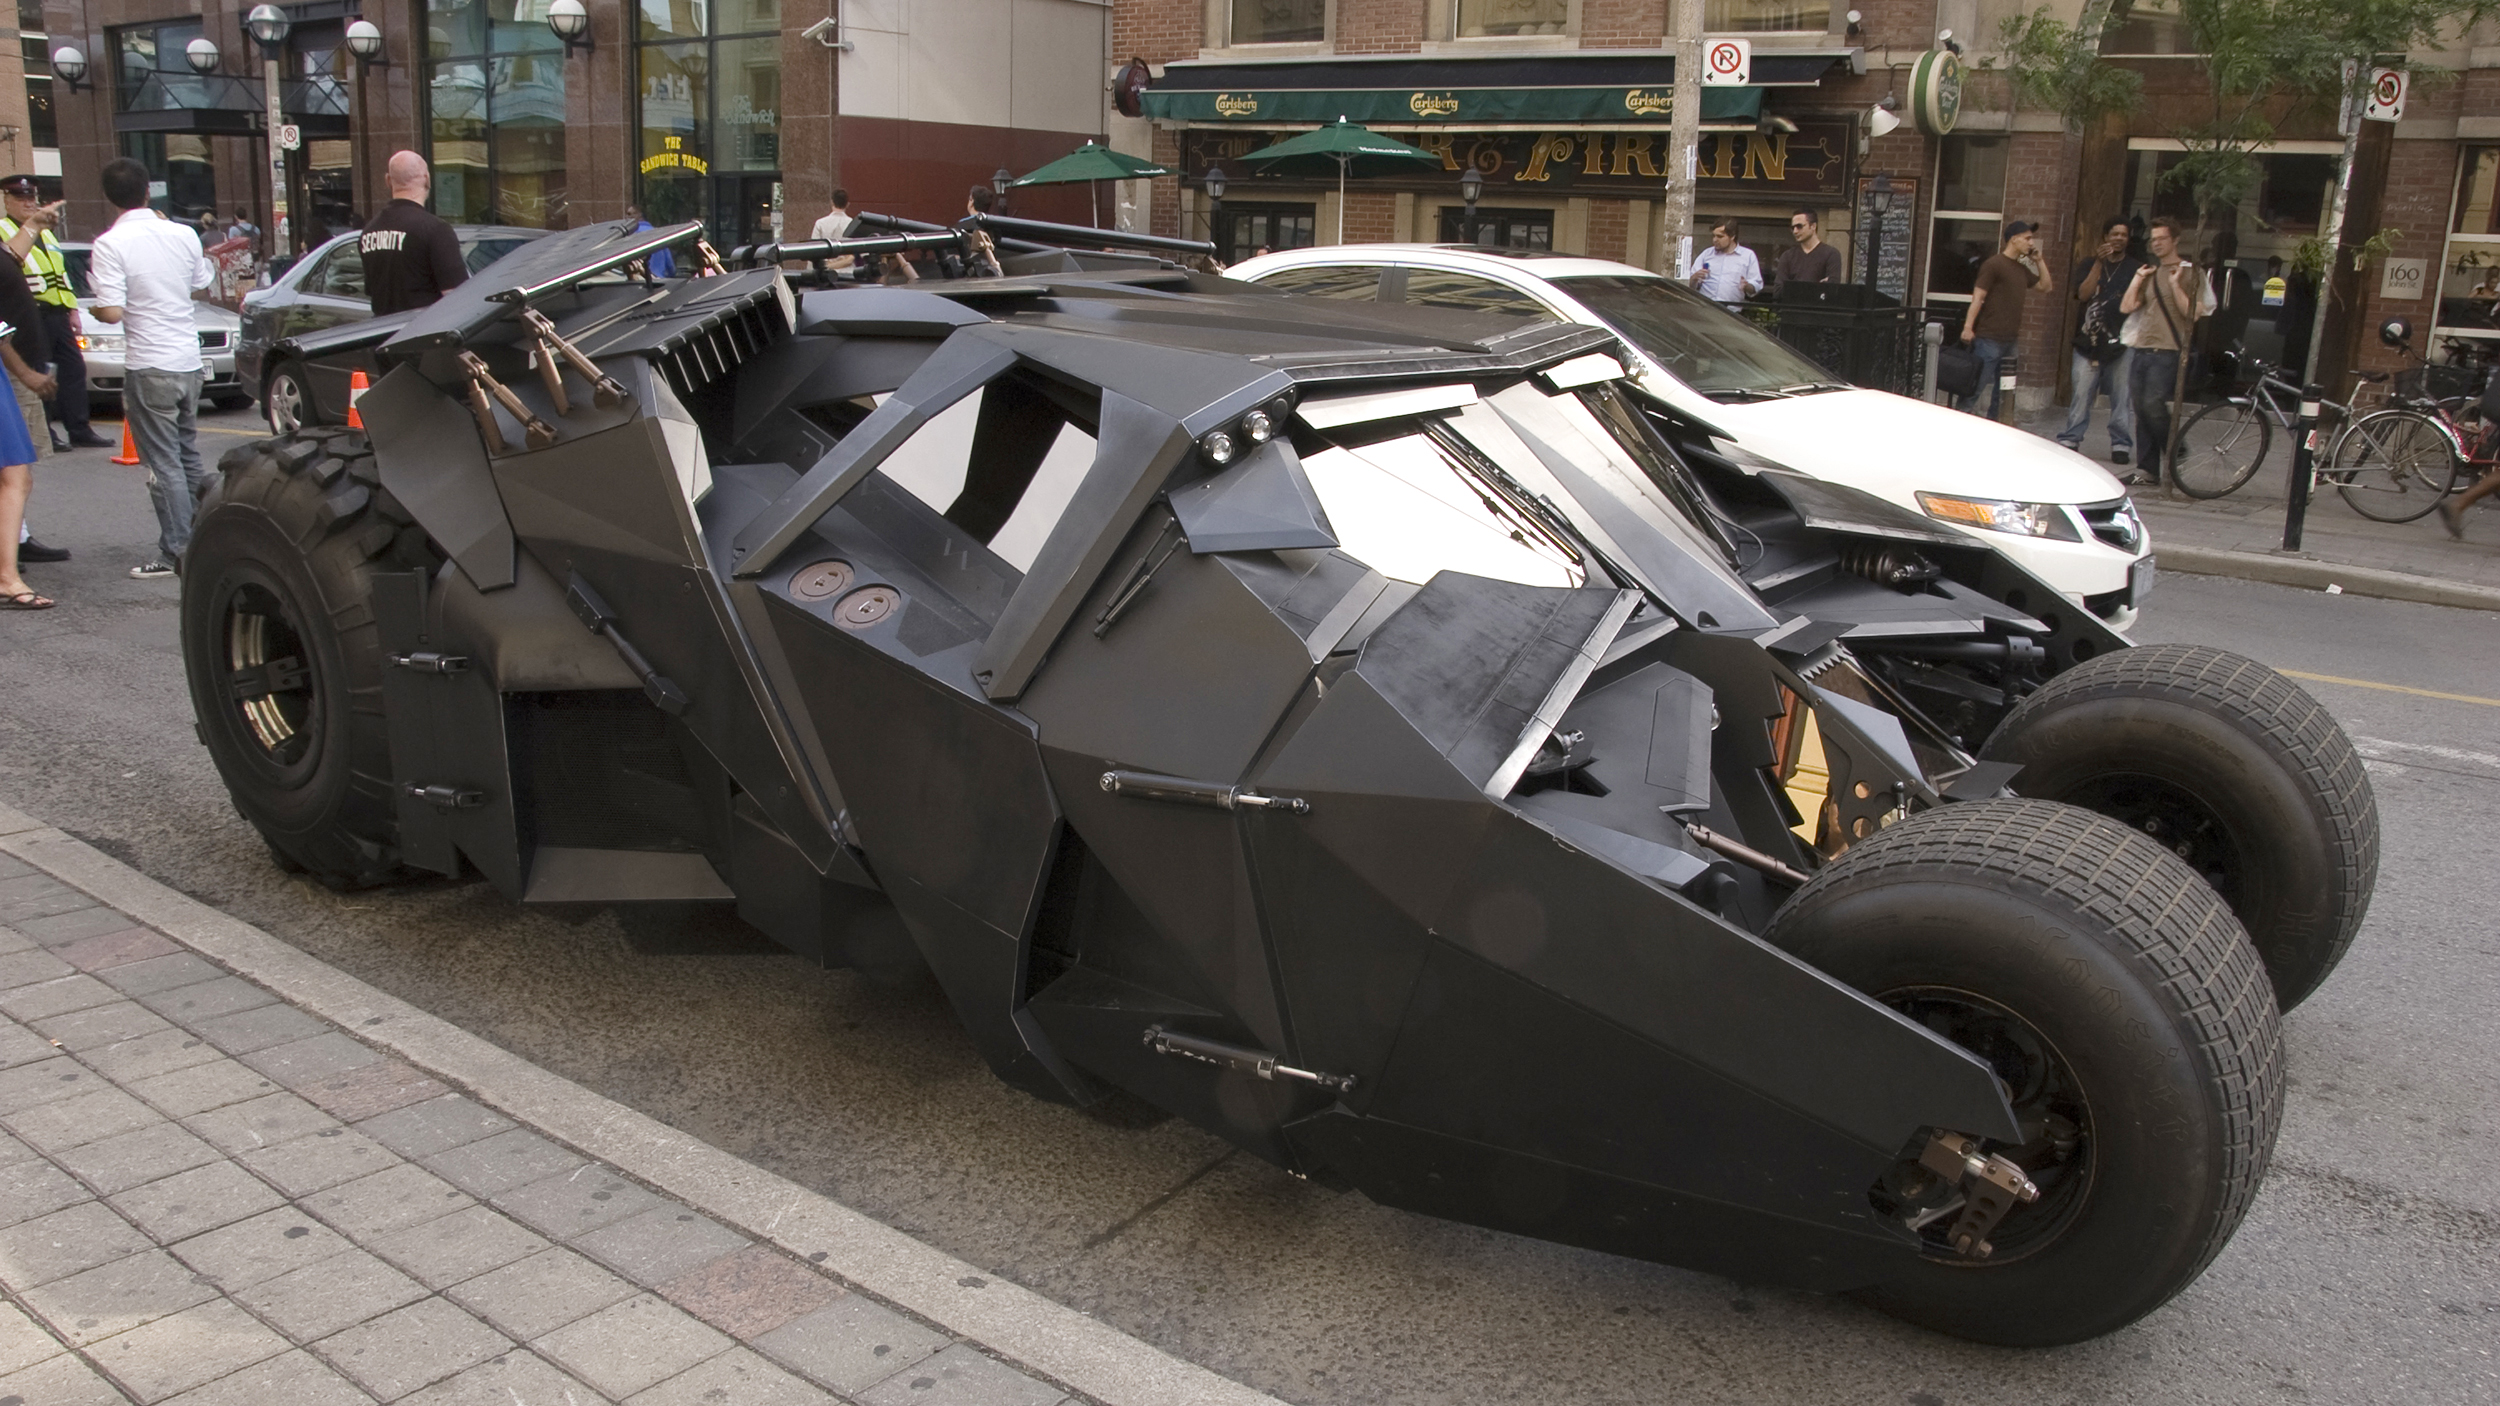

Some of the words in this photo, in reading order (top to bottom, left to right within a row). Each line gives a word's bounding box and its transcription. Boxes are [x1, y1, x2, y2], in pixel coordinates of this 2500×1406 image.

[1216, 94, 1257, 115] Carlsberg
[1410, 93, 1458, 115] Carlsberg
[1626, 90, 1673, 113] Carlsber
[665, 136, 681, 150] THE
[640, 153, 679, 174] SANDWICH
[682, 154, 707, 175] TABLE
[361, 230, 406, 254] SECURITY
[2390, 263, 2420, 281] 160
[2388, 281, 2406, 289] John
